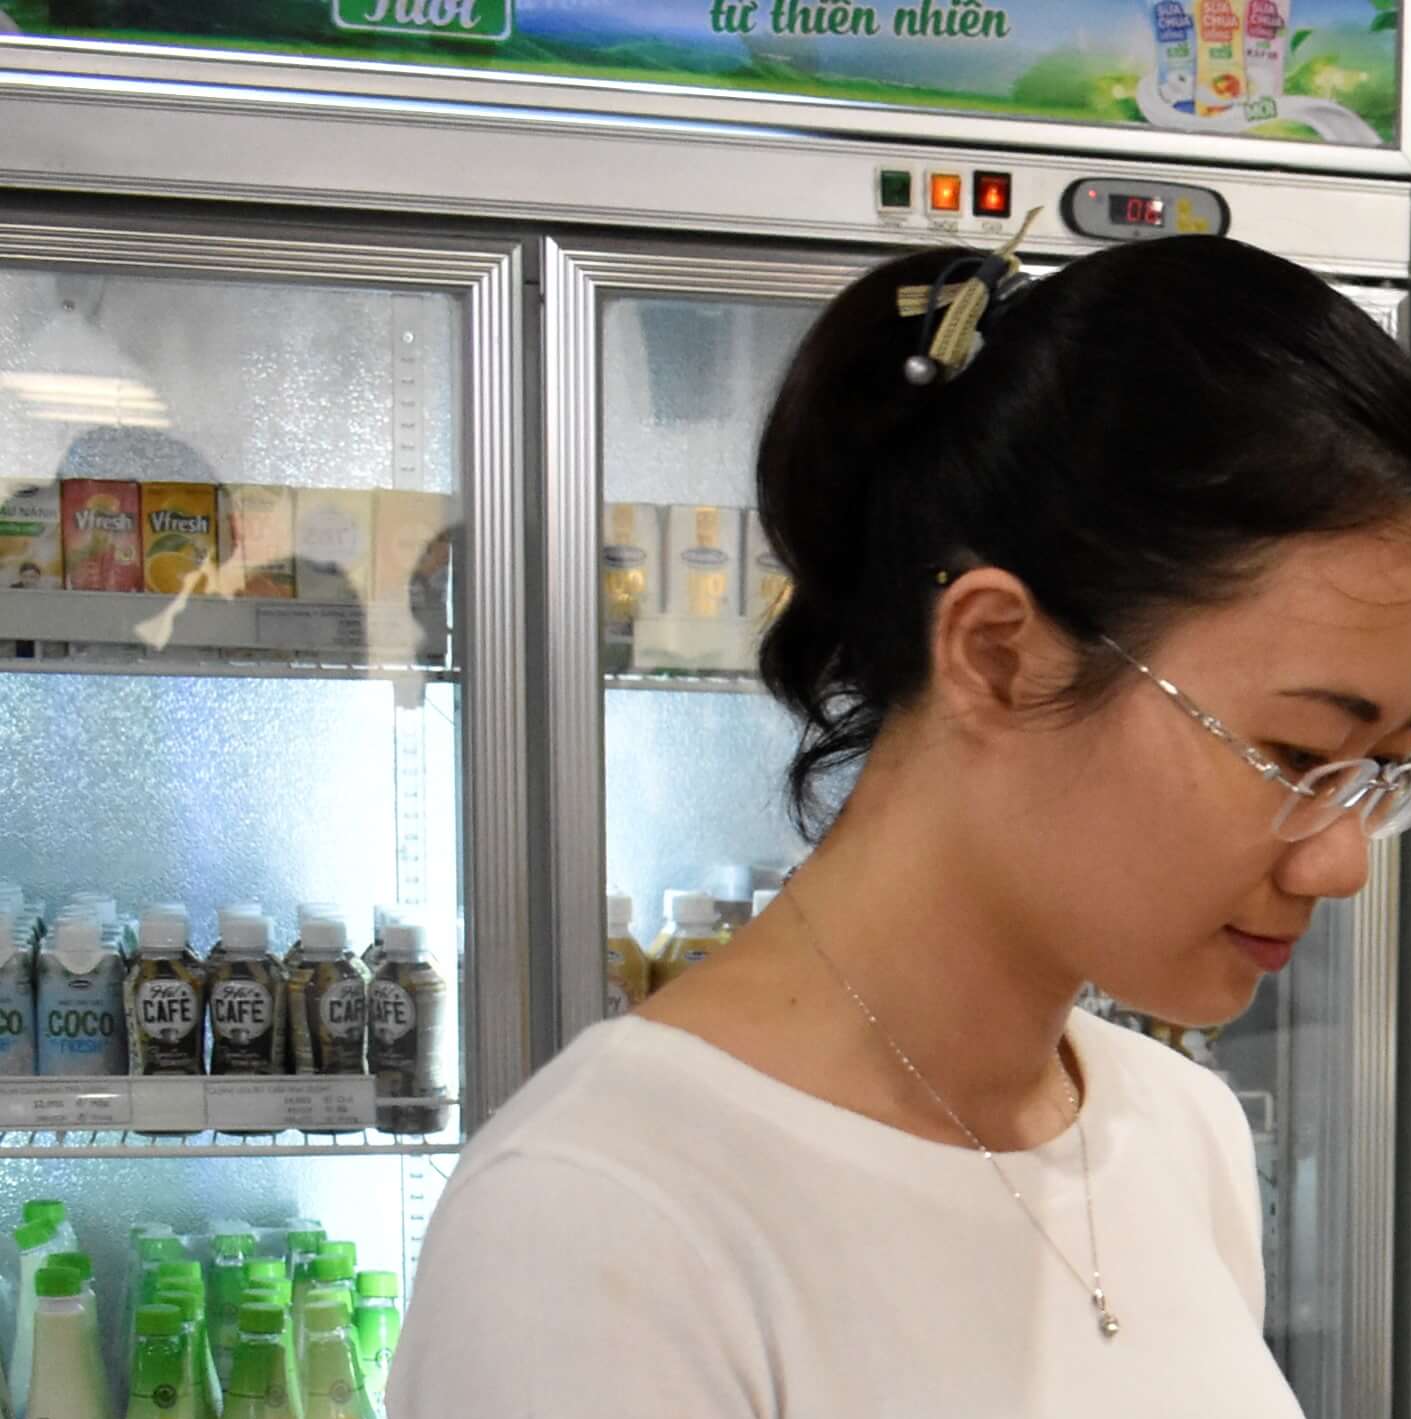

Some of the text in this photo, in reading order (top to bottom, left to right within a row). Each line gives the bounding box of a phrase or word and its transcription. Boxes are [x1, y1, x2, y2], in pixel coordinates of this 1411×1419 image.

[75, 509, 135, 532] Vfresh
[150, 509, 209, 535] Vfresh
[48, 1009, 114, 1039] COCO
[329, 1000, 366, 1024] CAF
